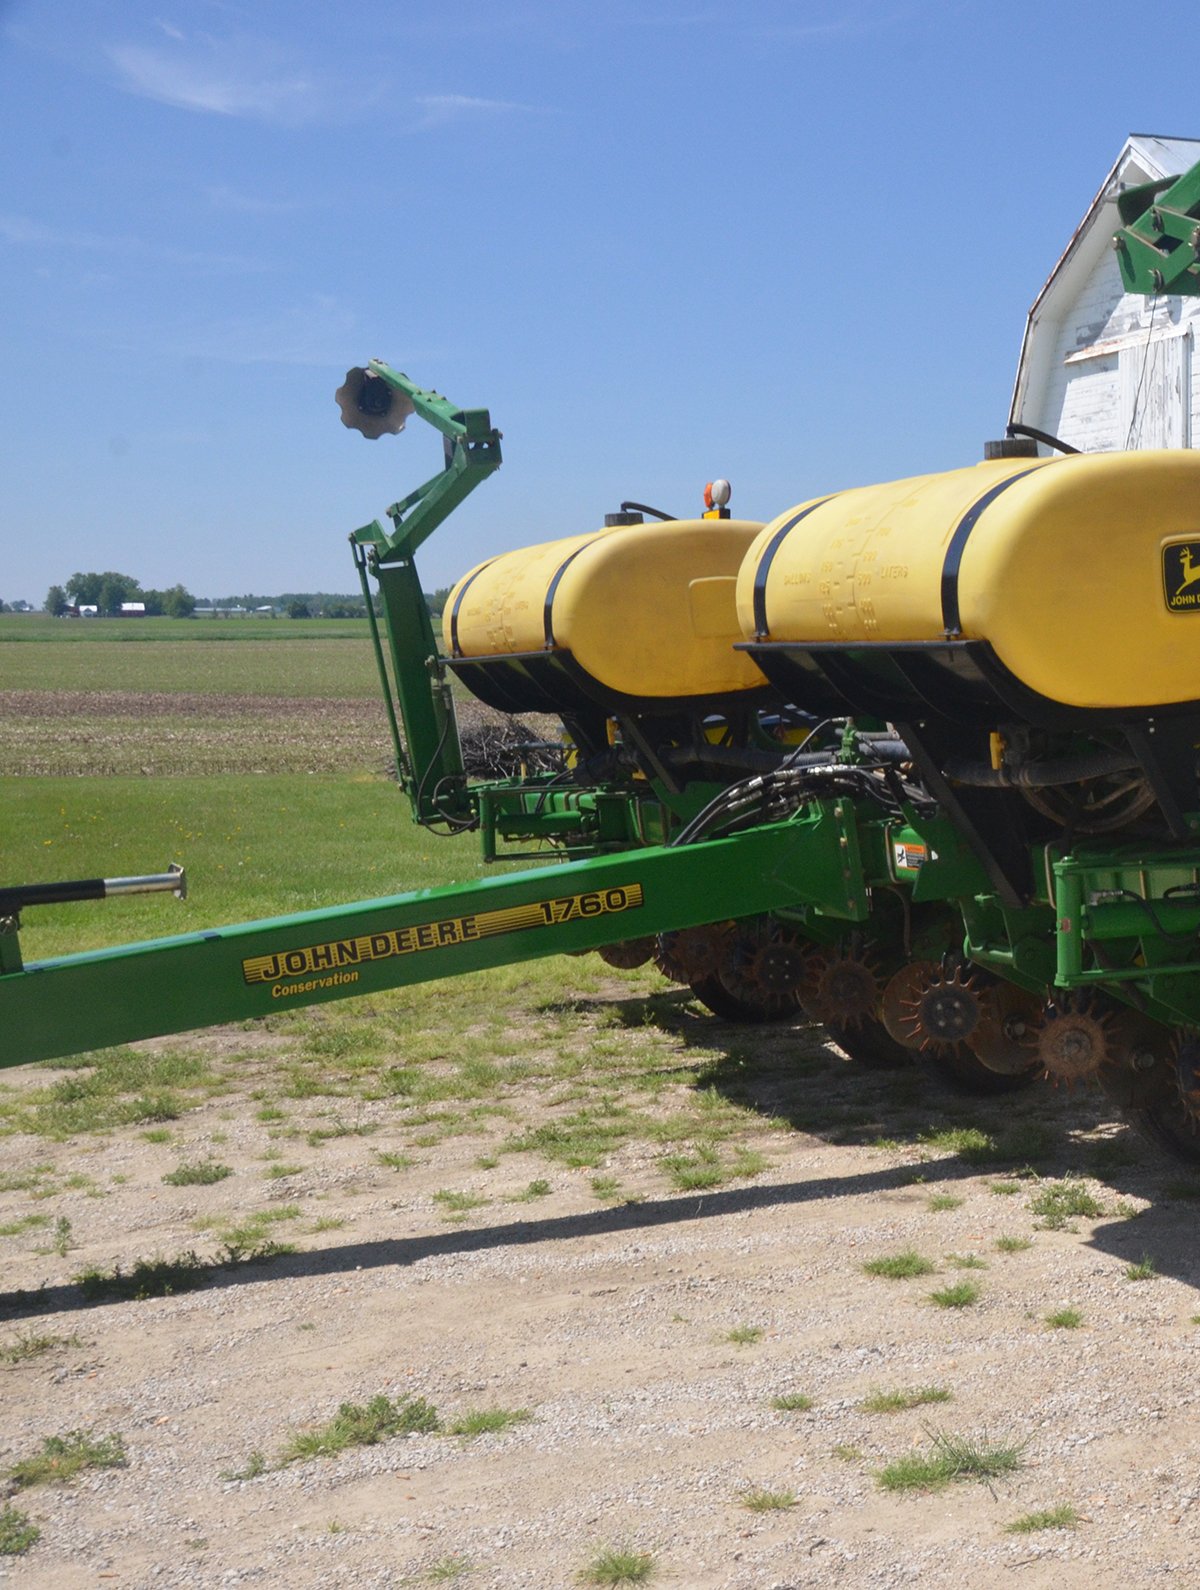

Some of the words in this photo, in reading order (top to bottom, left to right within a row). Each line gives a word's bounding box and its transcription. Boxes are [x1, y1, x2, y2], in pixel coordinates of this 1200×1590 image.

[880, 564, 909, 579] LITERS
[1170, 594, 1195, 606] JOHN
[261, 940, 360, 981] JOHN
[370, 916, 479, 957] DEERE
[538, 887, 629, 925] 1760
[271, 969, 359, 999] Conservation
